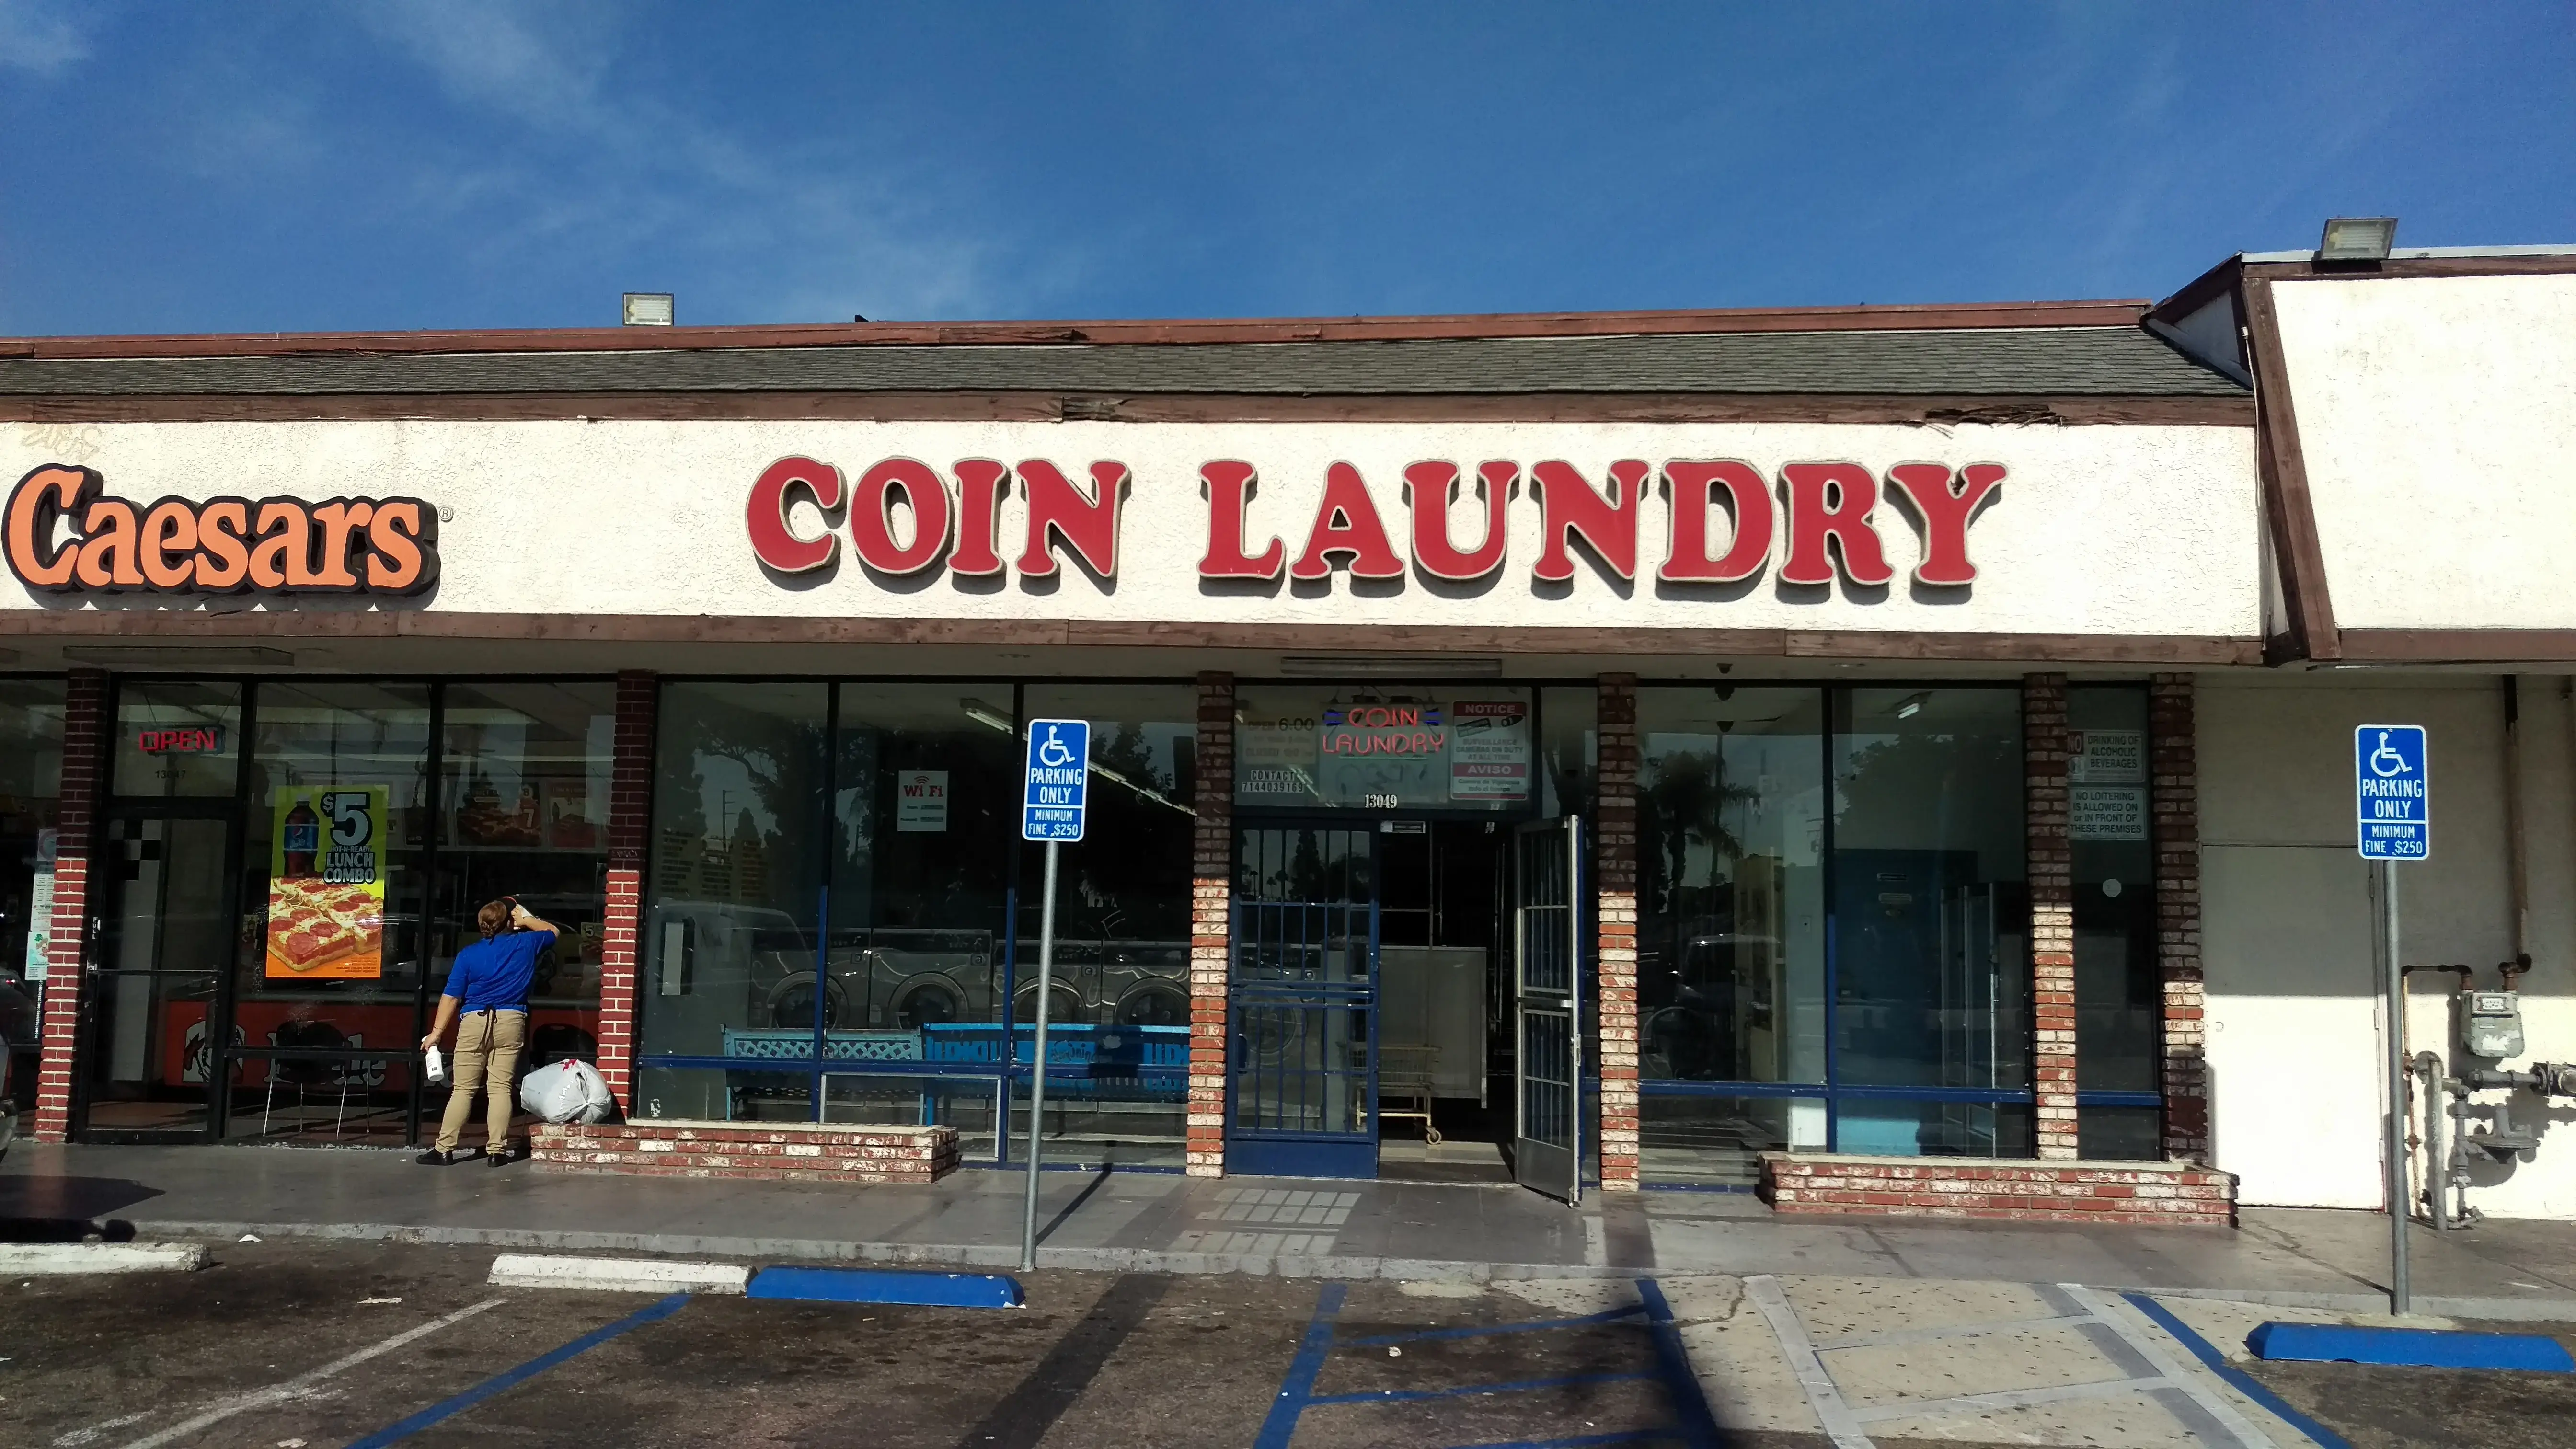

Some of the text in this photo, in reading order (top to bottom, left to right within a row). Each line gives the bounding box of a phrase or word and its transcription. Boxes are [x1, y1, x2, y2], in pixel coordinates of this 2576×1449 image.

[745, 454, 2010, 586] COIN LAUNDRY
[1, 463, 438, 594] Caesars
[1465, 704, 1515, 714] NOTICE
[1348, 707, 1418, 728] COIN
[139, 731, 216, 751] OPEN
[1322, 733, 1444, 754] LAUNDRY
[2067, 735, 2082, 752] NO
[2088, 736, 2139, 745] DRINKING OF
[2091, 747, 2136, 756] ALCOHOLIC
[1467, 765, 1512, 774] AVISO
[2090, 759, 2137, 768] BEVERAGES
[1031, 768, 1082, 785] PARKING
[1251, 770, 1295, 781] CONTACT
[903, 785, 943, 797] Wi Fi
[1242, 782, 1303, 792] 7144039169
[2362, 779, 2422, 798] PARKING
[1039, 786, 1072, 804] ONLY
[1365, 794, 1398, 809] 13049
[2076, 792, 2134, 801] NO LOITERING
[2073, 803, 2138, 812] IS ALLOWED ON
[2375, 799, 2411, 818] ONLY
[323, 794, 368, 846] $5
[1035, 809, 1073, 821] MINIMUM
[2084, 814, 2093, 822] IN
[2095, 814, 2123, 822] FRONT
[2126, 814, 2137, 822] OF
[1028, 823, 1079, 836] FINE $250
[2070, 824, 2142, 834] THESE PREMISES
[2372, 825, 2415, 838] MINIMUM
[2365, 840, 2423, 854] FINE $250
[326, 853, 373, 867] LUNCH
[323, 868, 375, 883] COMBO
